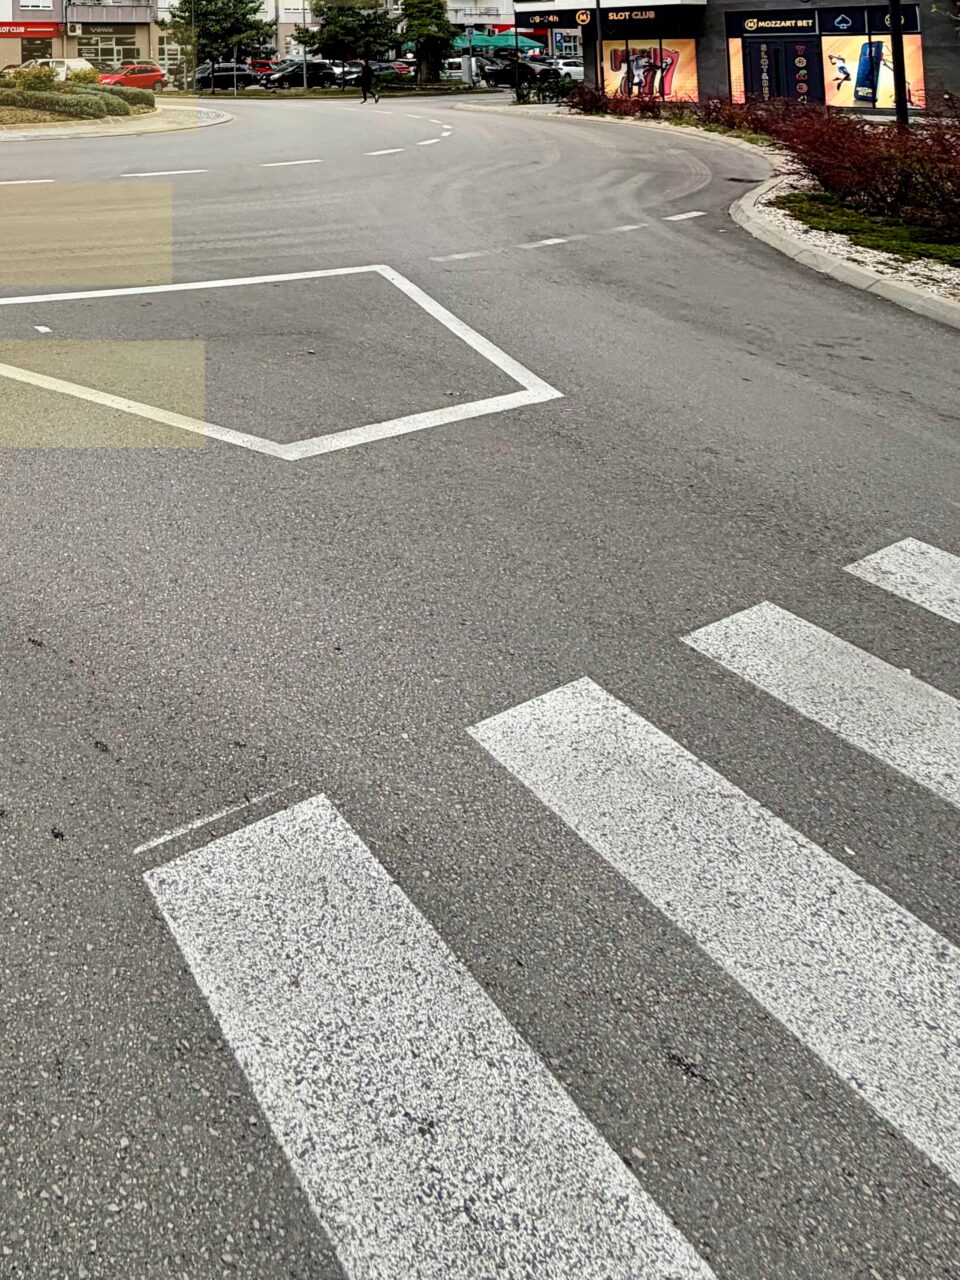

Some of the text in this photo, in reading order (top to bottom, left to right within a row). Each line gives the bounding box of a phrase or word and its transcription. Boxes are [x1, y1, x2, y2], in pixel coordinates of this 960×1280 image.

[608, 10, 655, 20] SLOT CLUB
[758, 19, 813, 28] MOZZART BET
